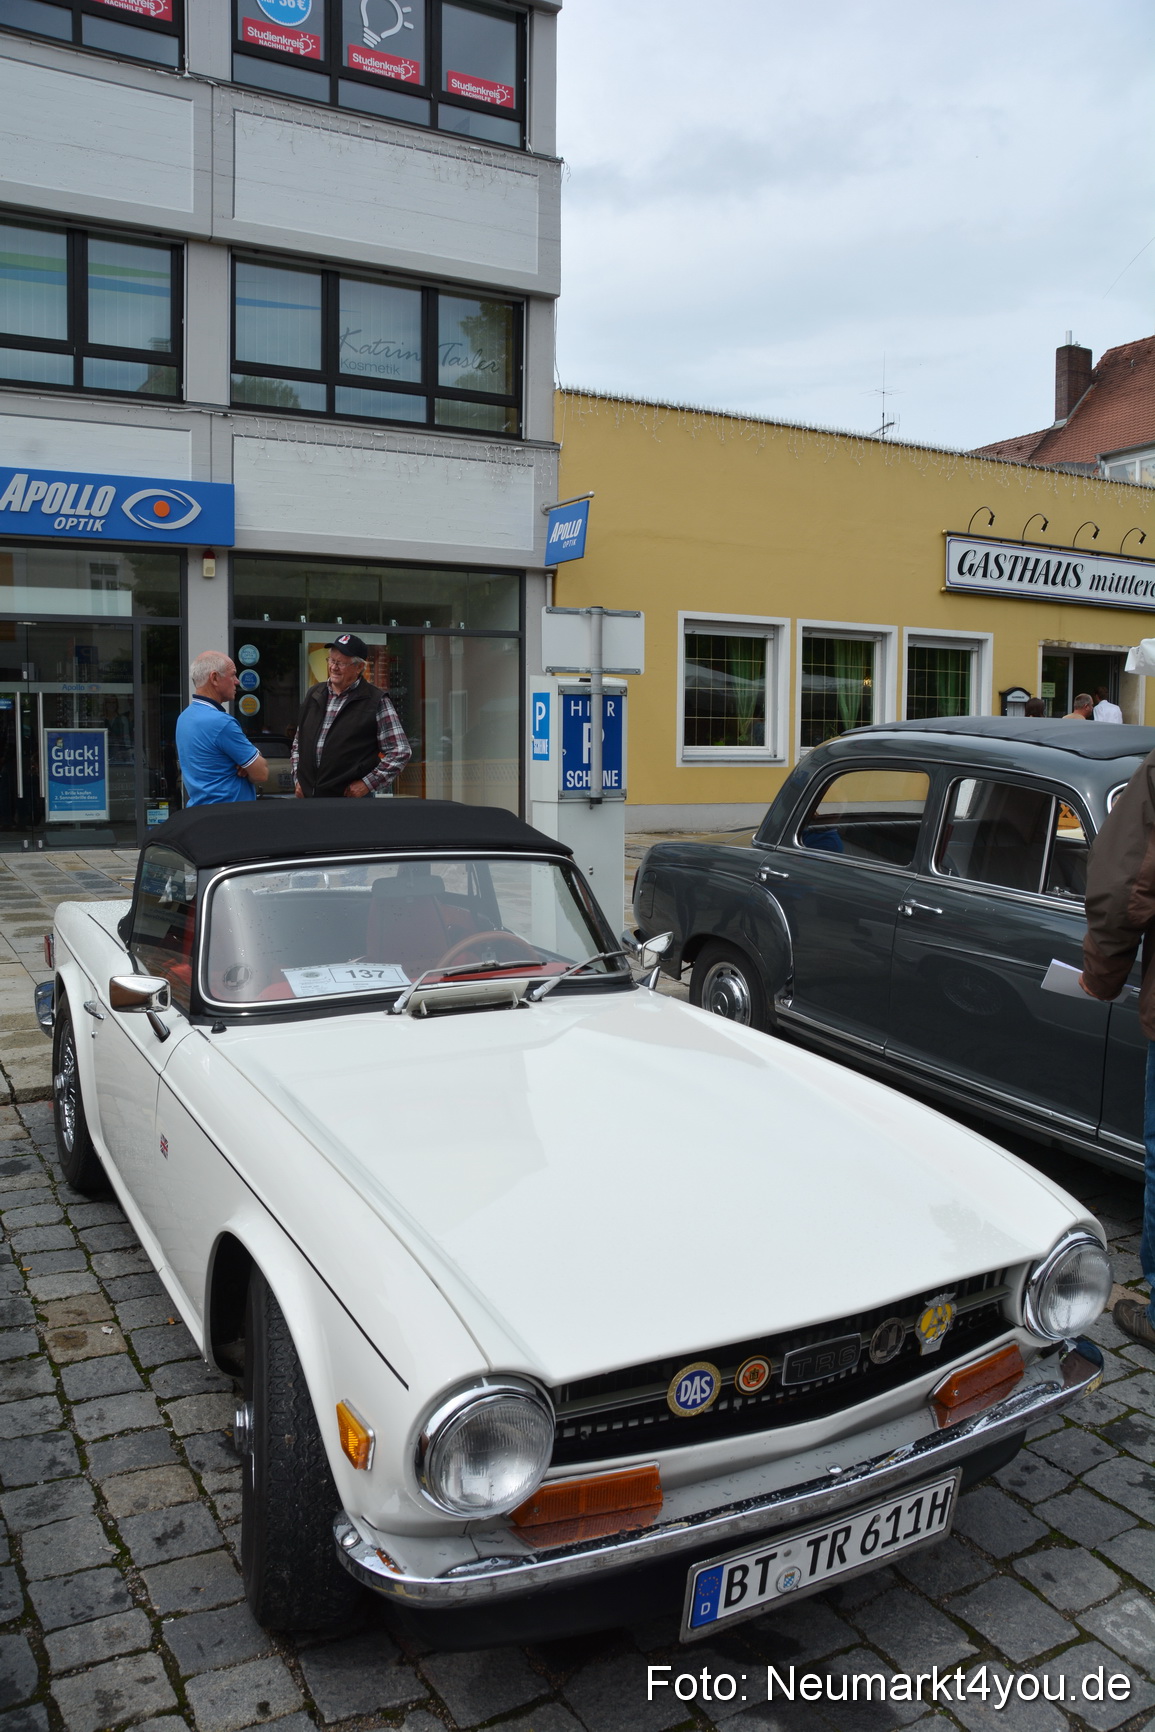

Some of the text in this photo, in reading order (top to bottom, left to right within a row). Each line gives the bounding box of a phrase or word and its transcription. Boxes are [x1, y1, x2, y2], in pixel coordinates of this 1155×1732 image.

[104, 0, 143, 14] NACHHILFE
[247, 26, 304, 50] Studienkreis
[258, 39, 294, 53] NACHHILFE
[352, 53, 405, 75] Studienkreis
[362, 65, 395, 78] NACHHILFE
[451, 78, 500, 99] Studienkreis
[461, 90, 491, 103] NACHHILFE
[339, 327, 500, 373] Katrin Tasler
[340, 357, 400, 376] Kosmetik
[0, 473, 117, 517] APOLLO
[53, 517, 106, 532] OPTIK
[549, 518, 583, 544] APOLLO
[562, 538, 577, 549] OPTIK
[957, 549, 1085, 590] GASTHAUS
[61, 684, 85, 692] Apollo
[536, 701, 546, 731] P
[570, 700, 615, 717] HIR
[51, 745, 99, 760] Guck!
[51, 761, 99, 777] Guck!
[566, 770, 619, 788] SCHNE
[345, 969, 385, 979] 137
[791, 1344, 857, 1378] TR6
[680, 1375, 711, 1406] DAS
[723, 1486, 952, 1609] BT TR 611H
[700, 1602, 710, 1616] D
